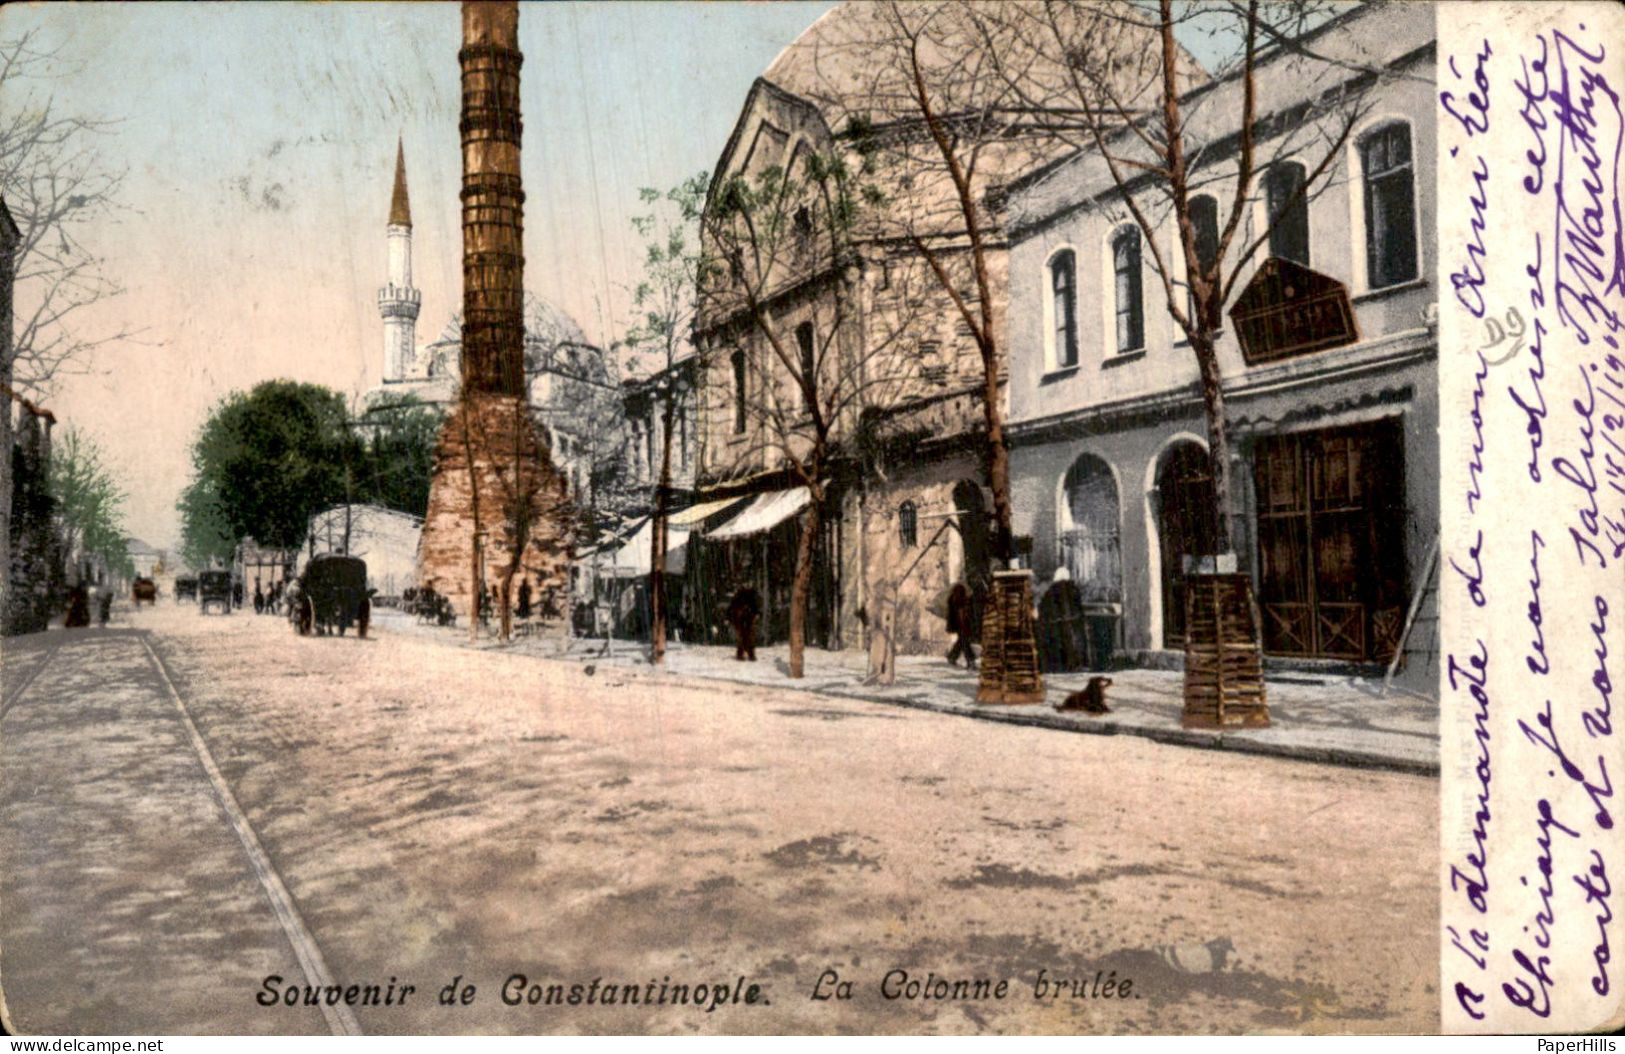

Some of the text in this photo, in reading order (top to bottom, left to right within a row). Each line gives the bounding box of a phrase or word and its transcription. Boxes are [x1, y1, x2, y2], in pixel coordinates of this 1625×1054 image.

[1514, 33, 1548, 194] cette
[1508, 231, 1547, 483] adresse
[1468, 349, 1487, 514] mon
[1449, 529, 1485, 606] de
[1526, 529, 1549, 674] vous
[1582, 594, 1612, 738] vous
[1448, 638, 1490, 913] demande
[1582, 755, 1613, 829] et
[1573, 848, 1612, 996] carte
